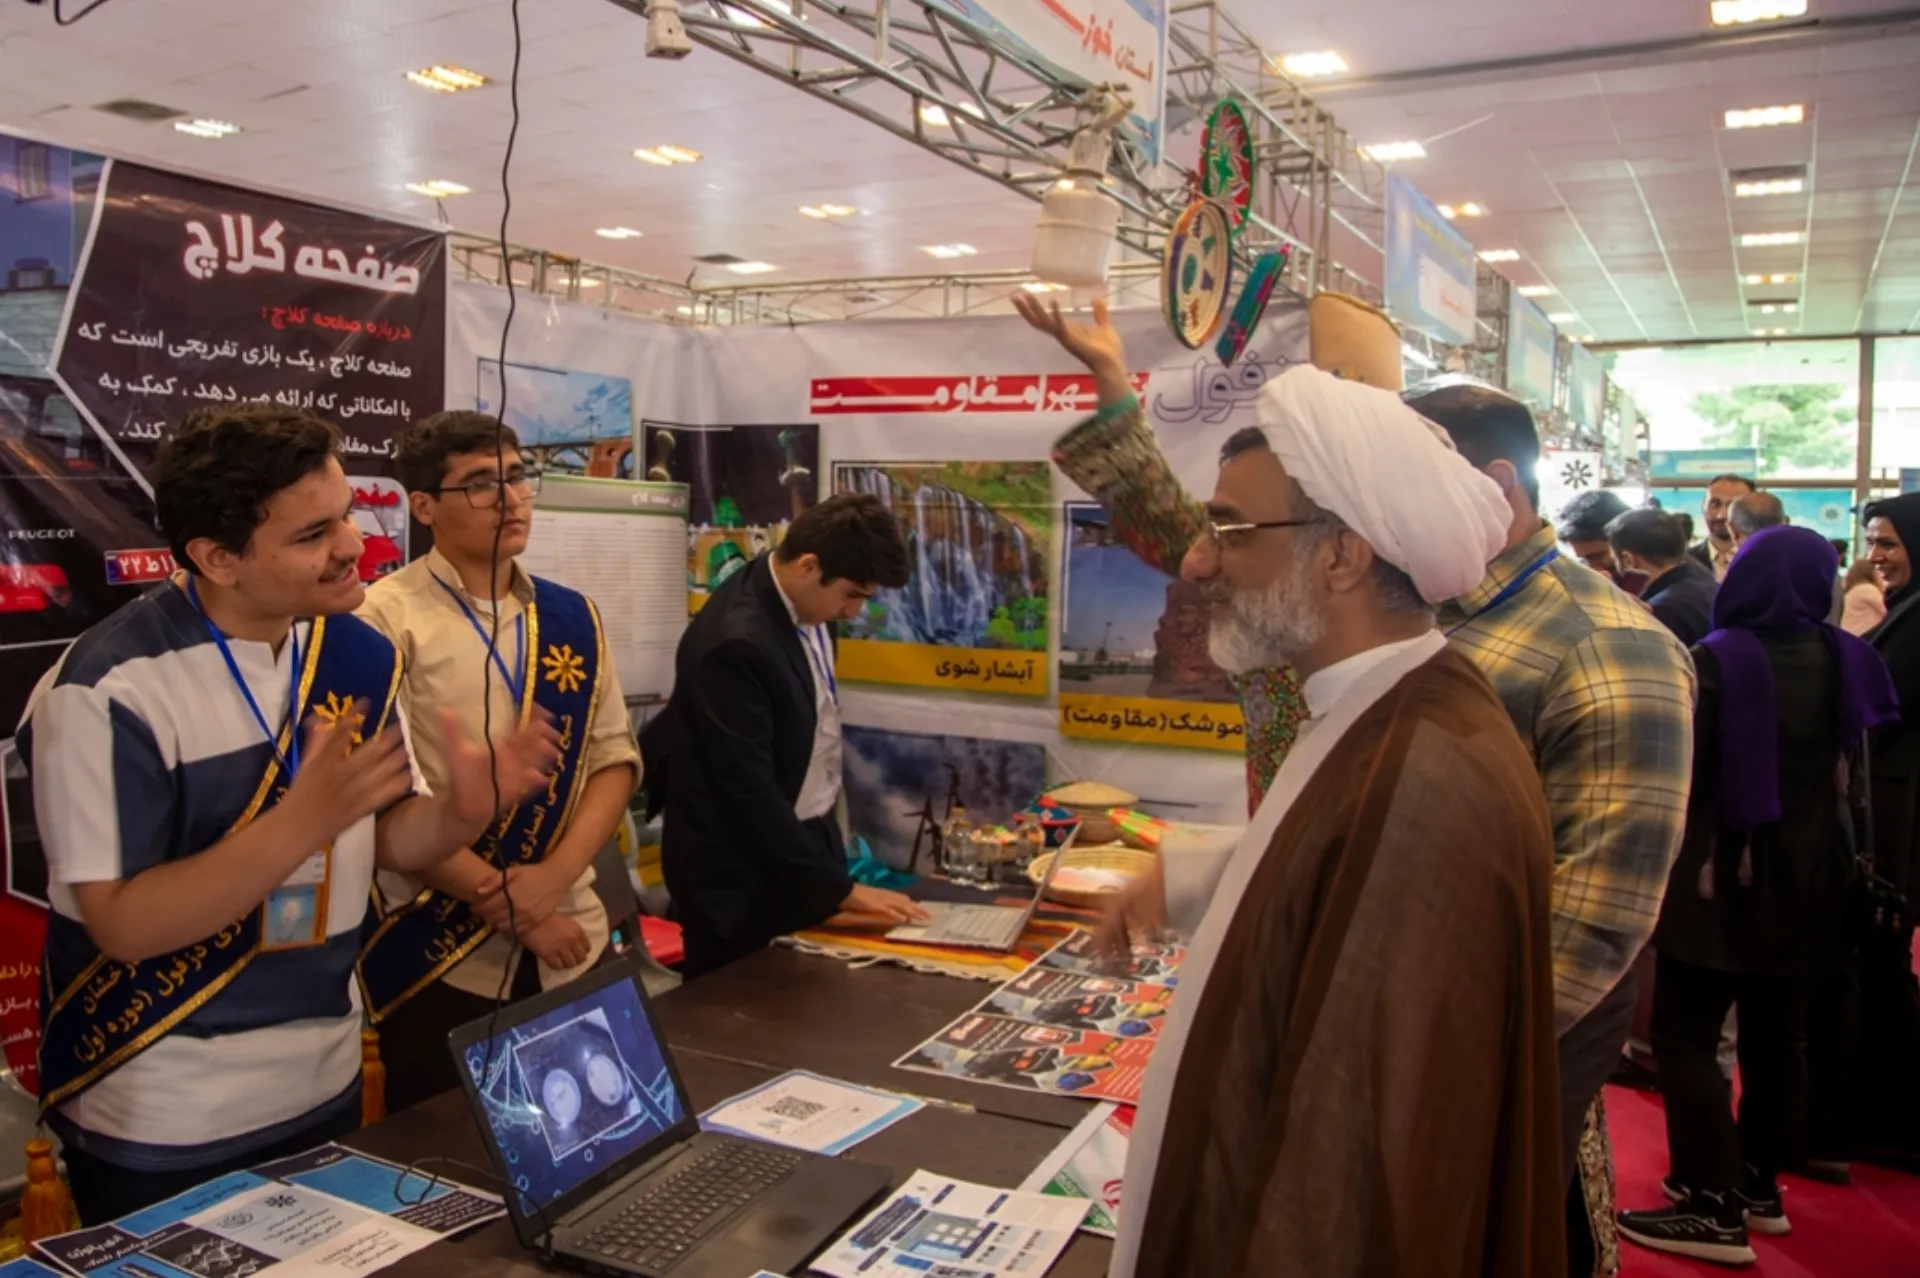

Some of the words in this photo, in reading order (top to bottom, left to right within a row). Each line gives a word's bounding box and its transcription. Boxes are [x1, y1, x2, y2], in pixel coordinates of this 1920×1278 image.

[184, 213, 286, 280] کلاچ
[294, 245, 420, 295] صفحه
[271, 306, 309, 330] کلاچ
[313, 312, 362, 333] صفحه
[77, 322, 106, 341] که
[111, 330, 164, 349] است
[366, 320, 412, 341] درباره
[168, 337, 239, 361] تفریحی
[242, 344, 282, 368] بازی
[286, 349, 316, 372] یک
[329, 354, 365, 378] کلاچ
[367, 358, 412, 378] صفحه
[98, 372, 121, 396] به
[125, 374, 178, 396] کمک
[193, 382, 237, 401] دهد
[317, 393, 338, 410] که
[340, 396, 398, 417] امکاناتی
[400, 399, 412, 421] با
[8, 528, 76, 541] PEUGEOT
[935, 657, 980, 680] شوی
[983, 658, 1035, 685] آبشار
[1169, 712, 1244, 740] موشک
[84, 960, 142, 1015] رخشان
